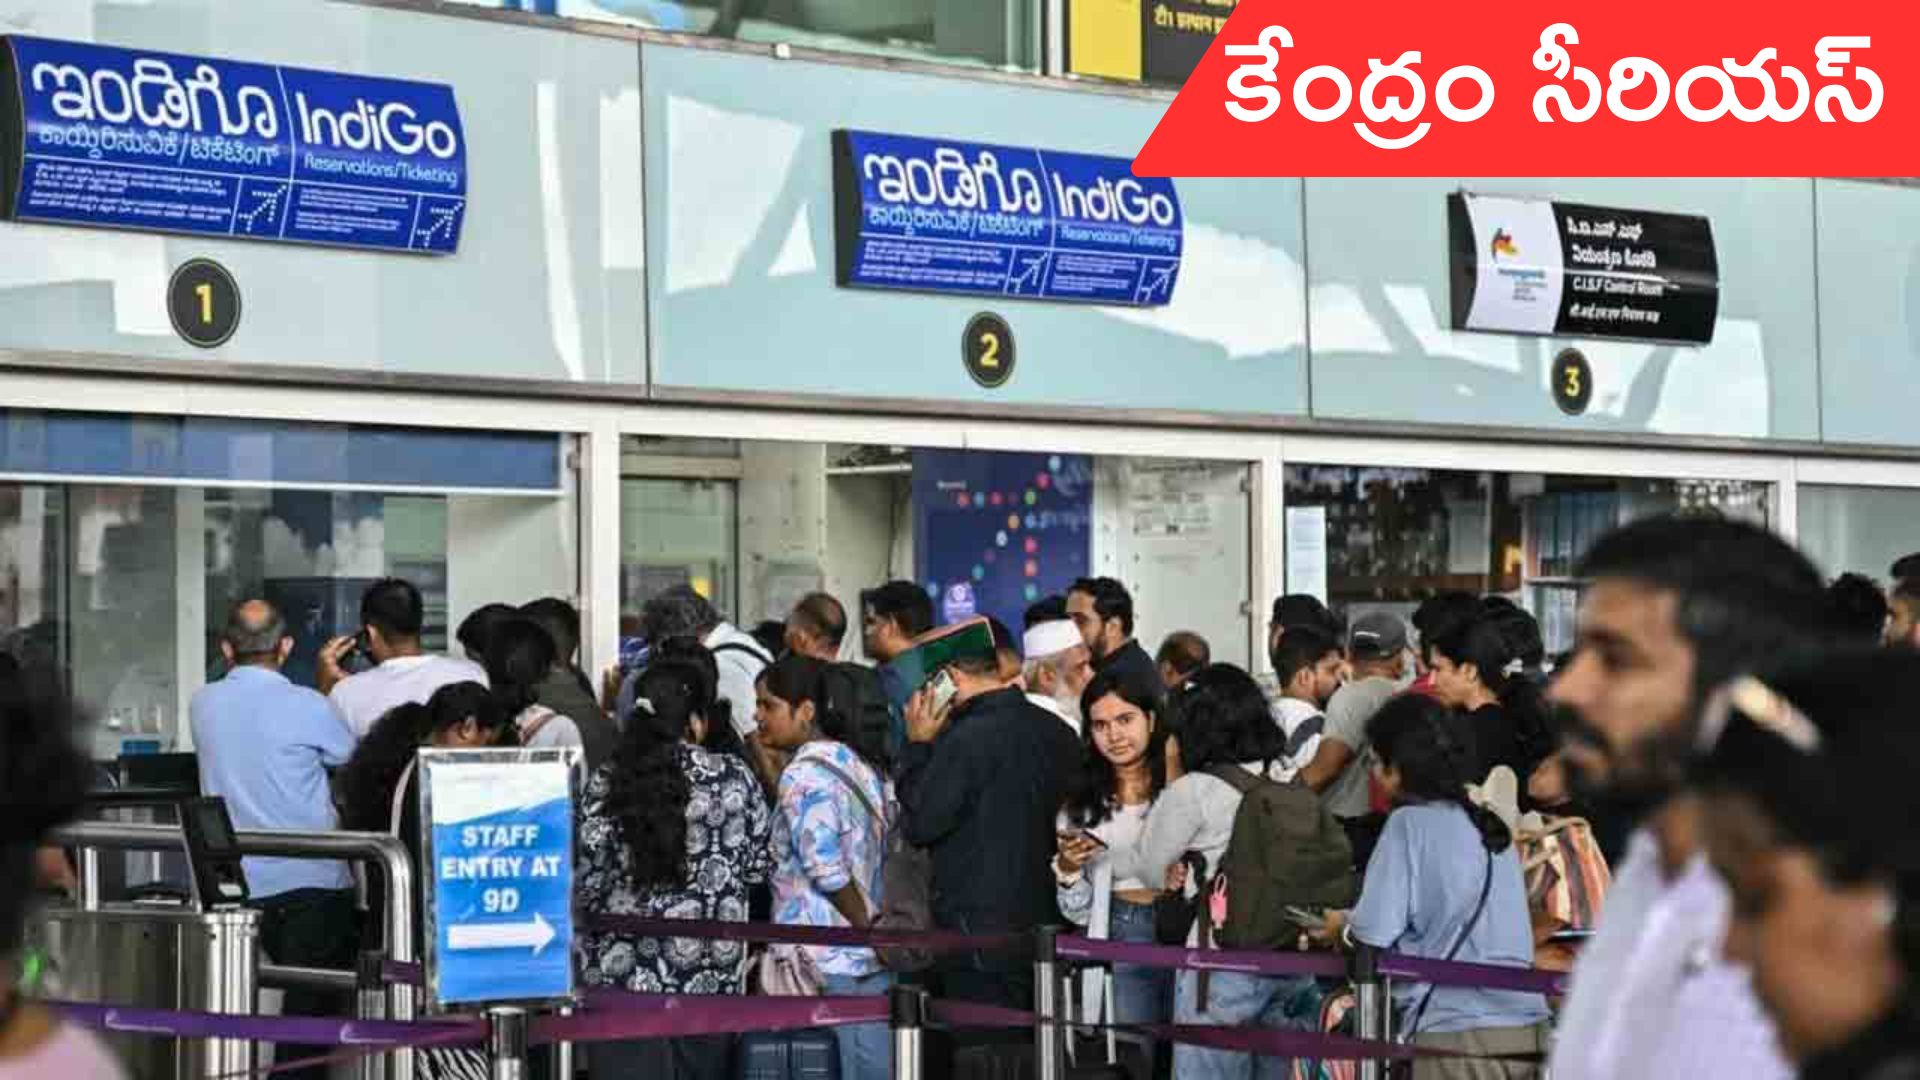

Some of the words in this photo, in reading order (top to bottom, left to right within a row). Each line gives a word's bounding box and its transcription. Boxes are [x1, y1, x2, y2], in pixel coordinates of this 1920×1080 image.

[295, 91, 457, 158] IndiGo
[304, 153, 457, 188] Reservations/Ticketing
[1054, 171, 1175, 227] IndiGo
[195, 284, 213, 325] 1
[1638, 282, 1664, 297] Room
[980, 333, 1000, 367] 2
[1564, 366, 1581, 397] 3
[460, 825, 540, 848] STAFF
[440, 857, 522, 880] ENTRY
[529, 855, 561, 877] AT
[483, 888, 519, 912] 9D
